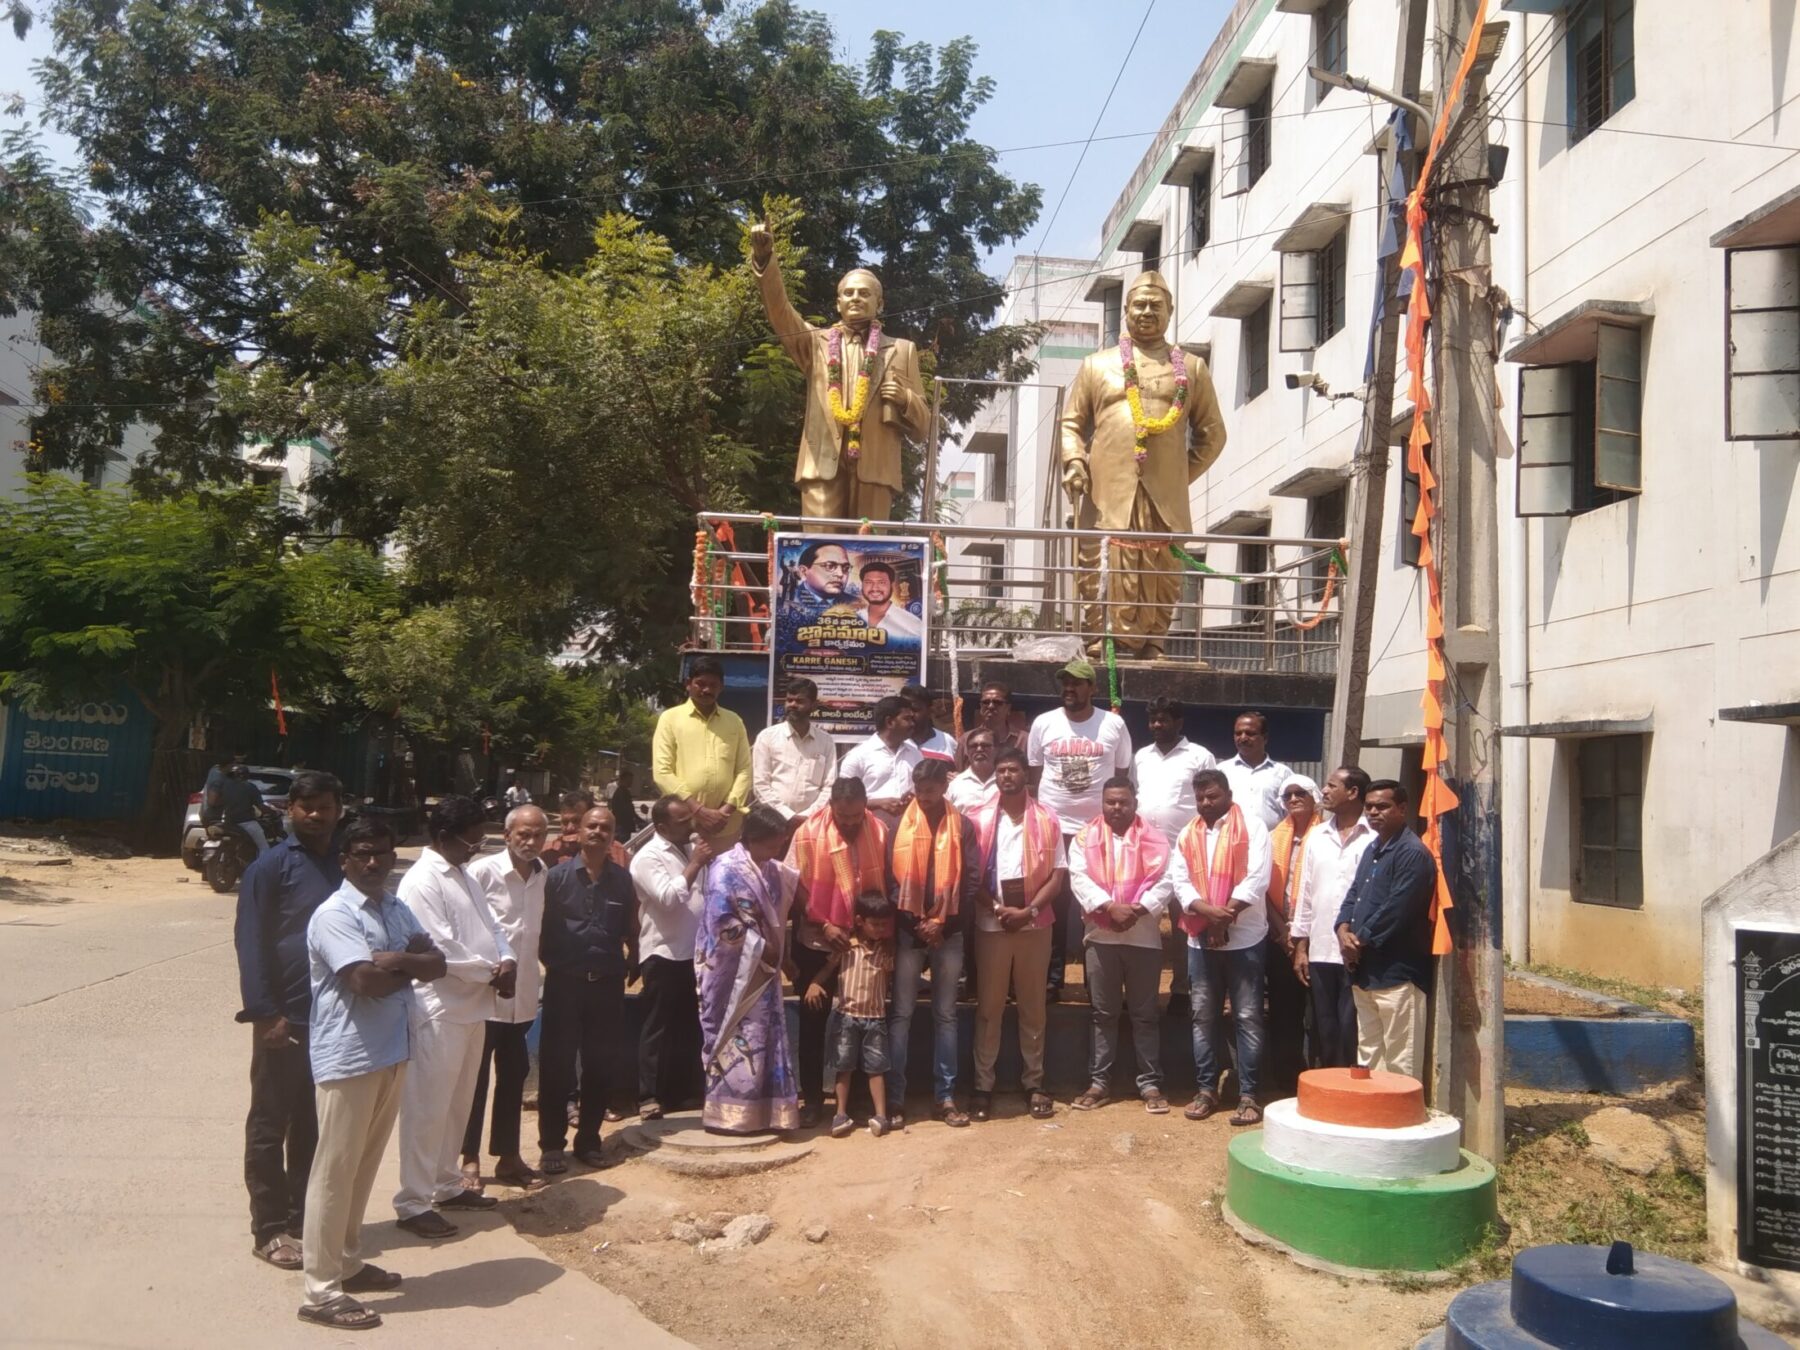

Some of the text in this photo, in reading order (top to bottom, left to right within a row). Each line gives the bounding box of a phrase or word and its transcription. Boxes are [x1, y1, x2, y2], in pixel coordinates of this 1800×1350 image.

[797, 625, 886, 647] జ్ఞానమాల
[793, 656, 858, 666] KARRE GANESH
[23, 730, 110, 752] తెలంగాణ
